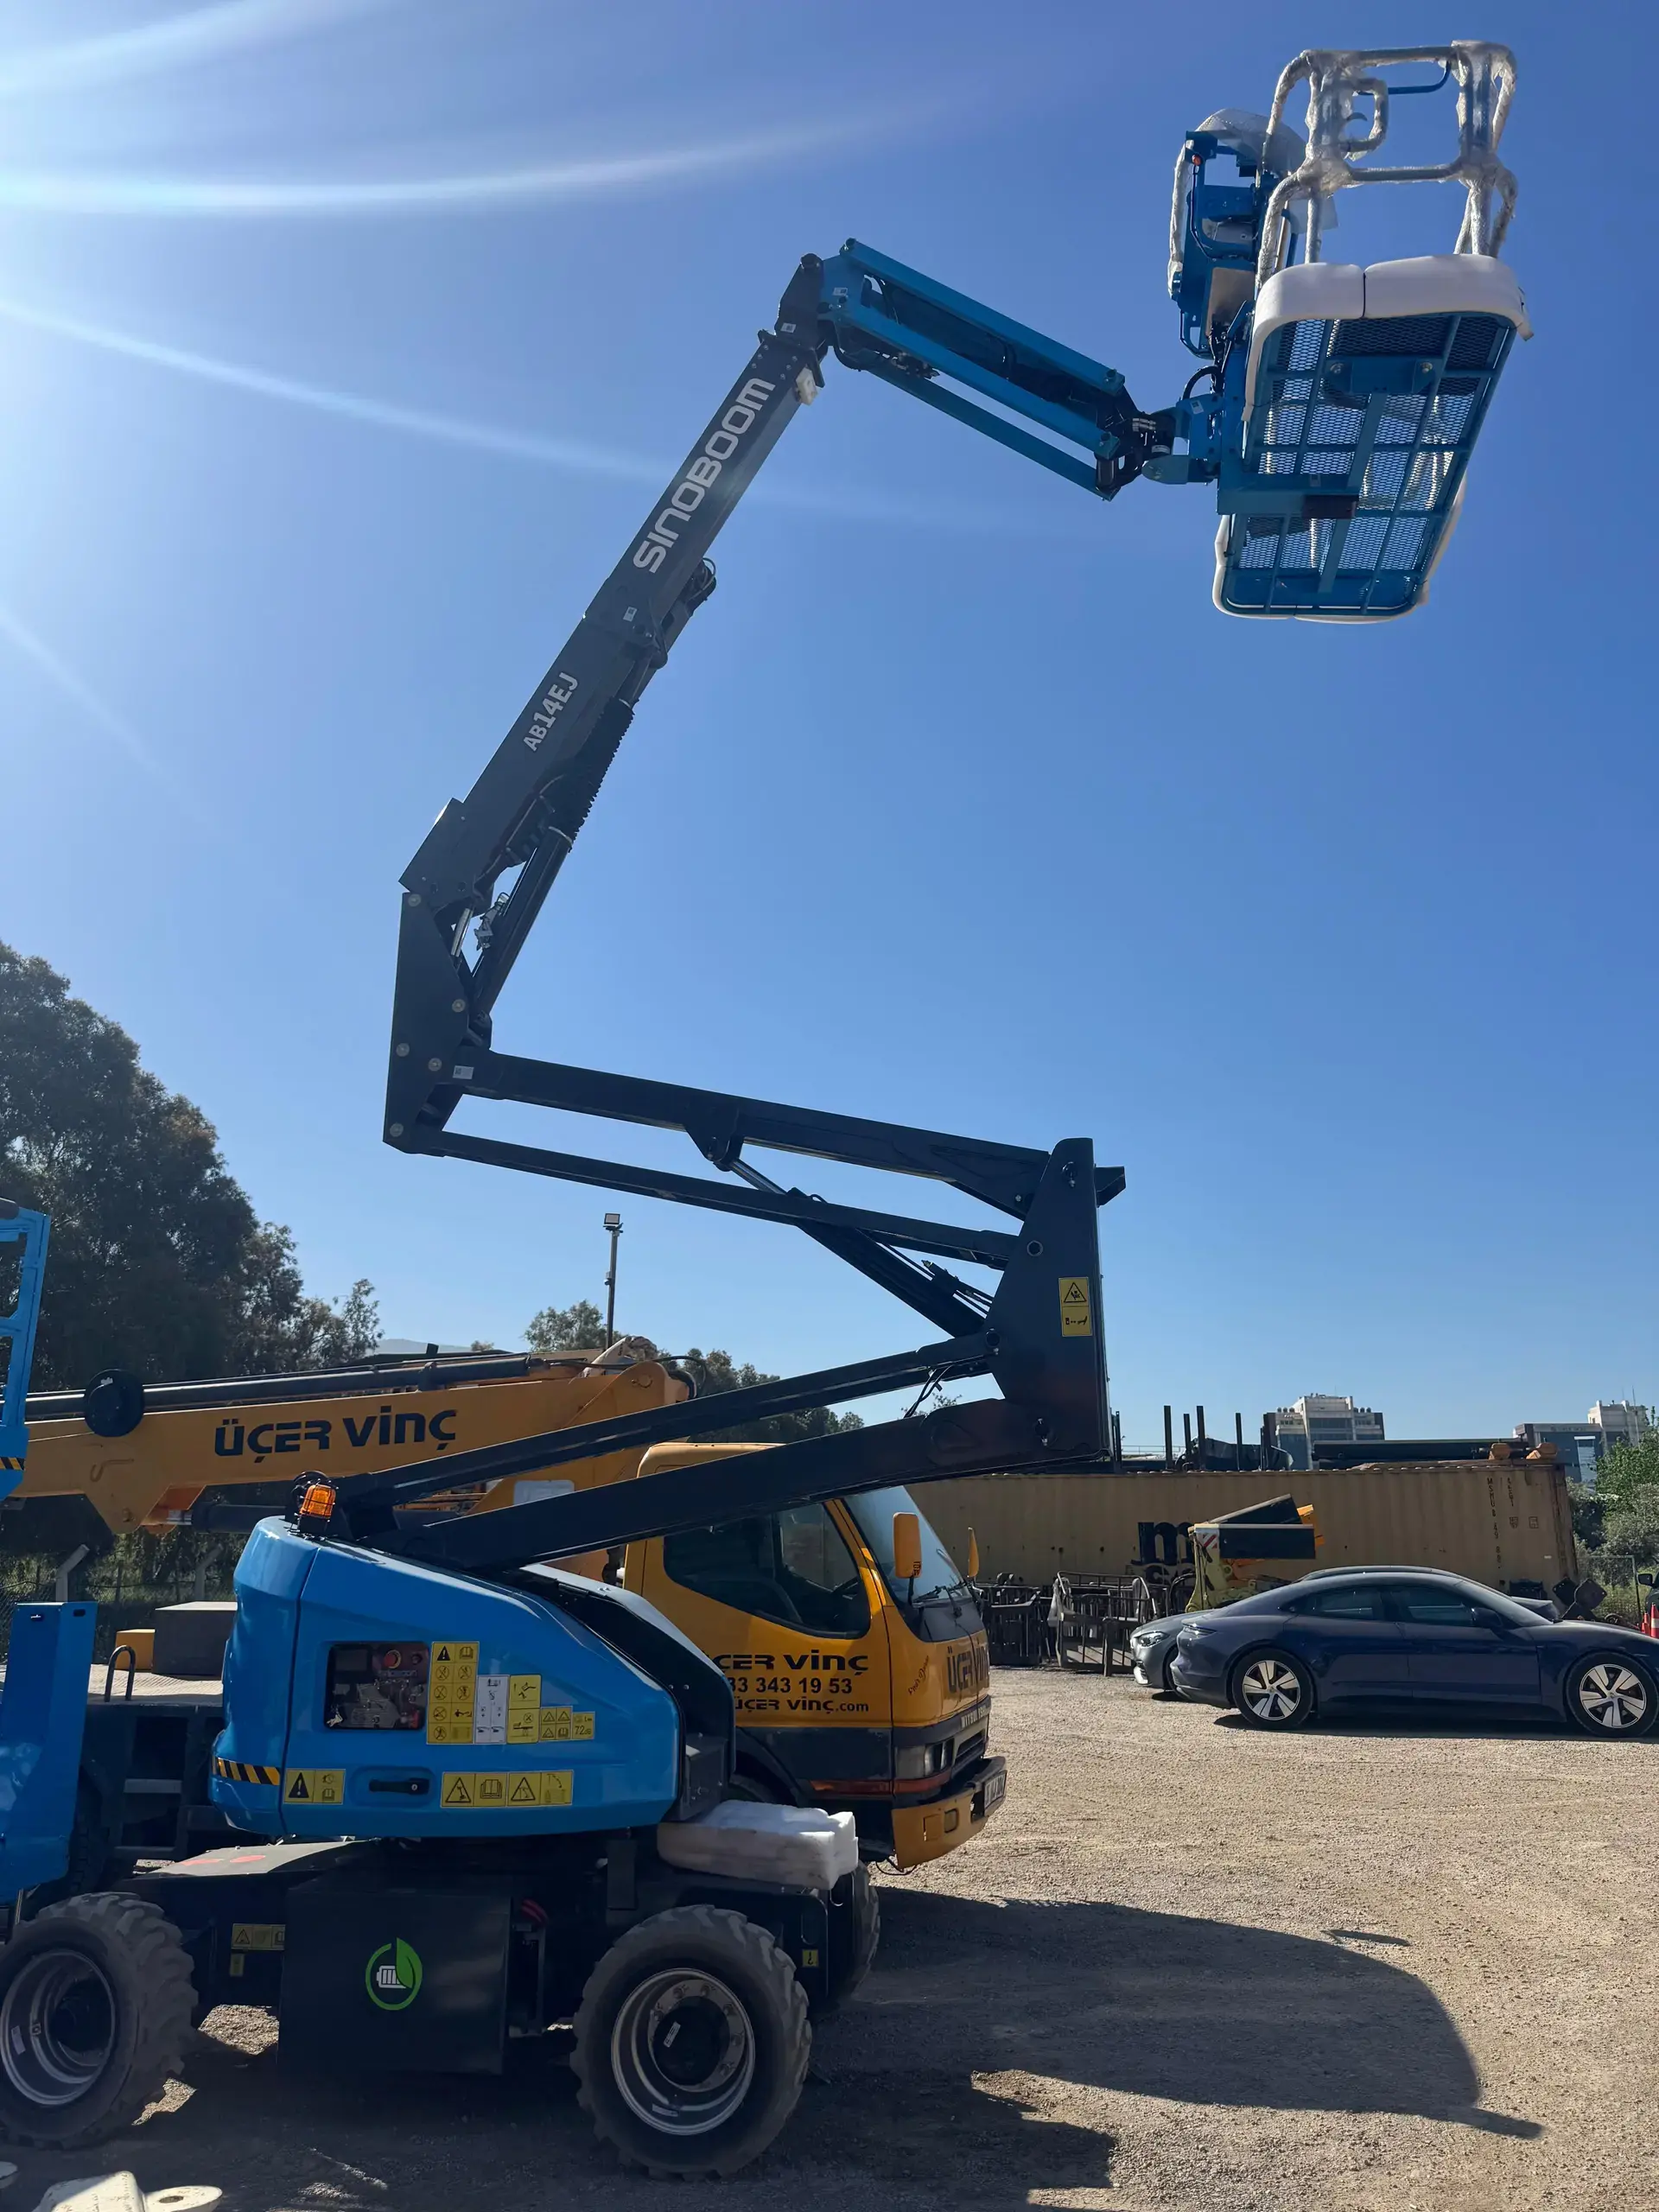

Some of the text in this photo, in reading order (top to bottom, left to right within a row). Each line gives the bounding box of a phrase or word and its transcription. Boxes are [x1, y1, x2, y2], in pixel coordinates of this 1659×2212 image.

[633, 378, 775, 573] SINOBOOM
[523, 671, 578, 751] AB14EJ
[756, 1677, 791, 1694] 343
[798, 1677, 822, 1694] 19
[829, 1678, 852, 1694] 53
